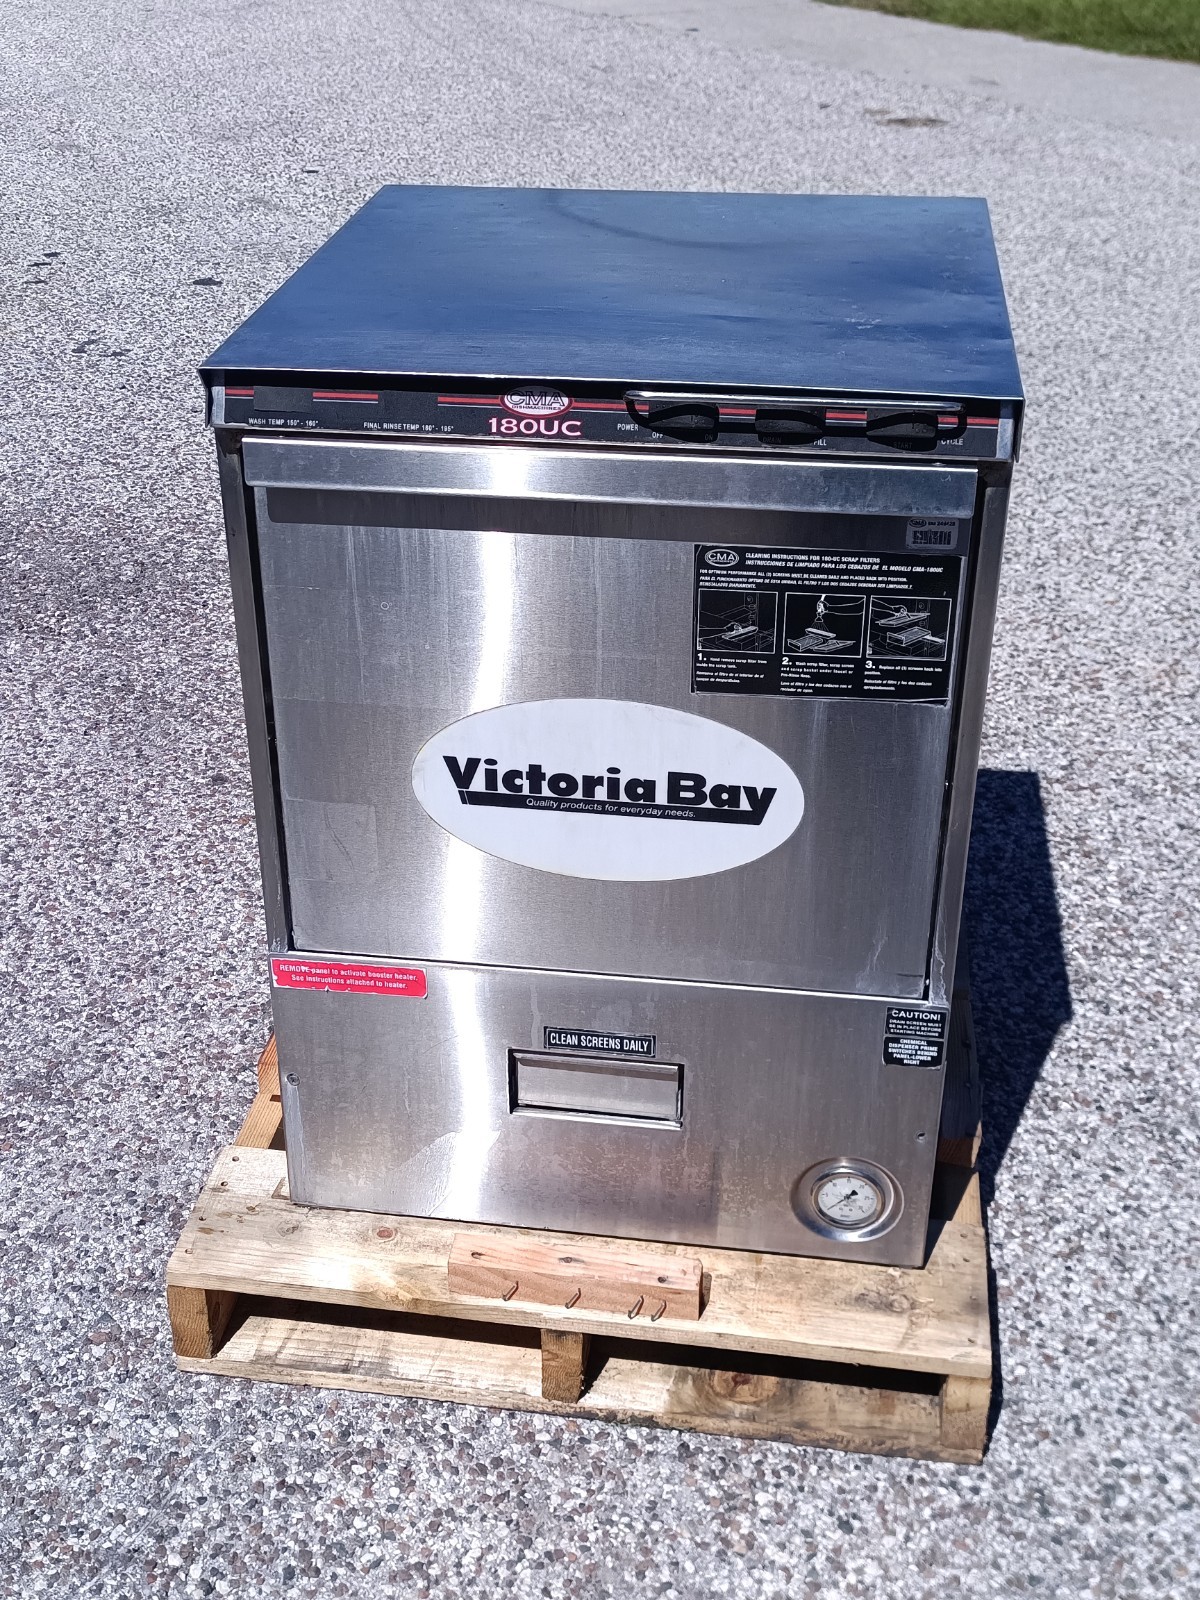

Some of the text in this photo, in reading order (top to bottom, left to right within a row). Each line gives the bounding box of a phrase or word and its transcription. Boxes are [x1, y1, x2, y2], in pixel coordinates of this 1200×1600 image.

[507, 389, 565, 407] CMA
[248, 418, 266, 426] WASH
[268, 418, 286, 426] TEMP
[383, 422, 402, 430] RINSE
[488, 417, 582, 437] 180UC
[617, 423, 639, 432] POWER
[708, 553, 736, 561] CMA
[745, 552, 771, 560] CLEANING
[745, 560, 786, 568] INSTRUCCIONES
[697, 652, 707, 661] 1.
[781, 656, 793, 666] 2.
[865, 660, 877, 670] 3.
[442, 755, 778, 823] Victoria Bay
[526, 798, 696, 818] Quality products for everyday needs.
[311, 968, 330, 976] panel
[394, 973, 418, 981] heater.
[291, 974, 305, 982] See
[306, 975, 345, 984] instructions
[346, 978, 375, 986] attached
[384, 981, 408, 989] heater.
[891, 1010, 941, 1021] CAUTION!
[550, 1032, 649, 1052] CLEAN SCREENS DAILY
